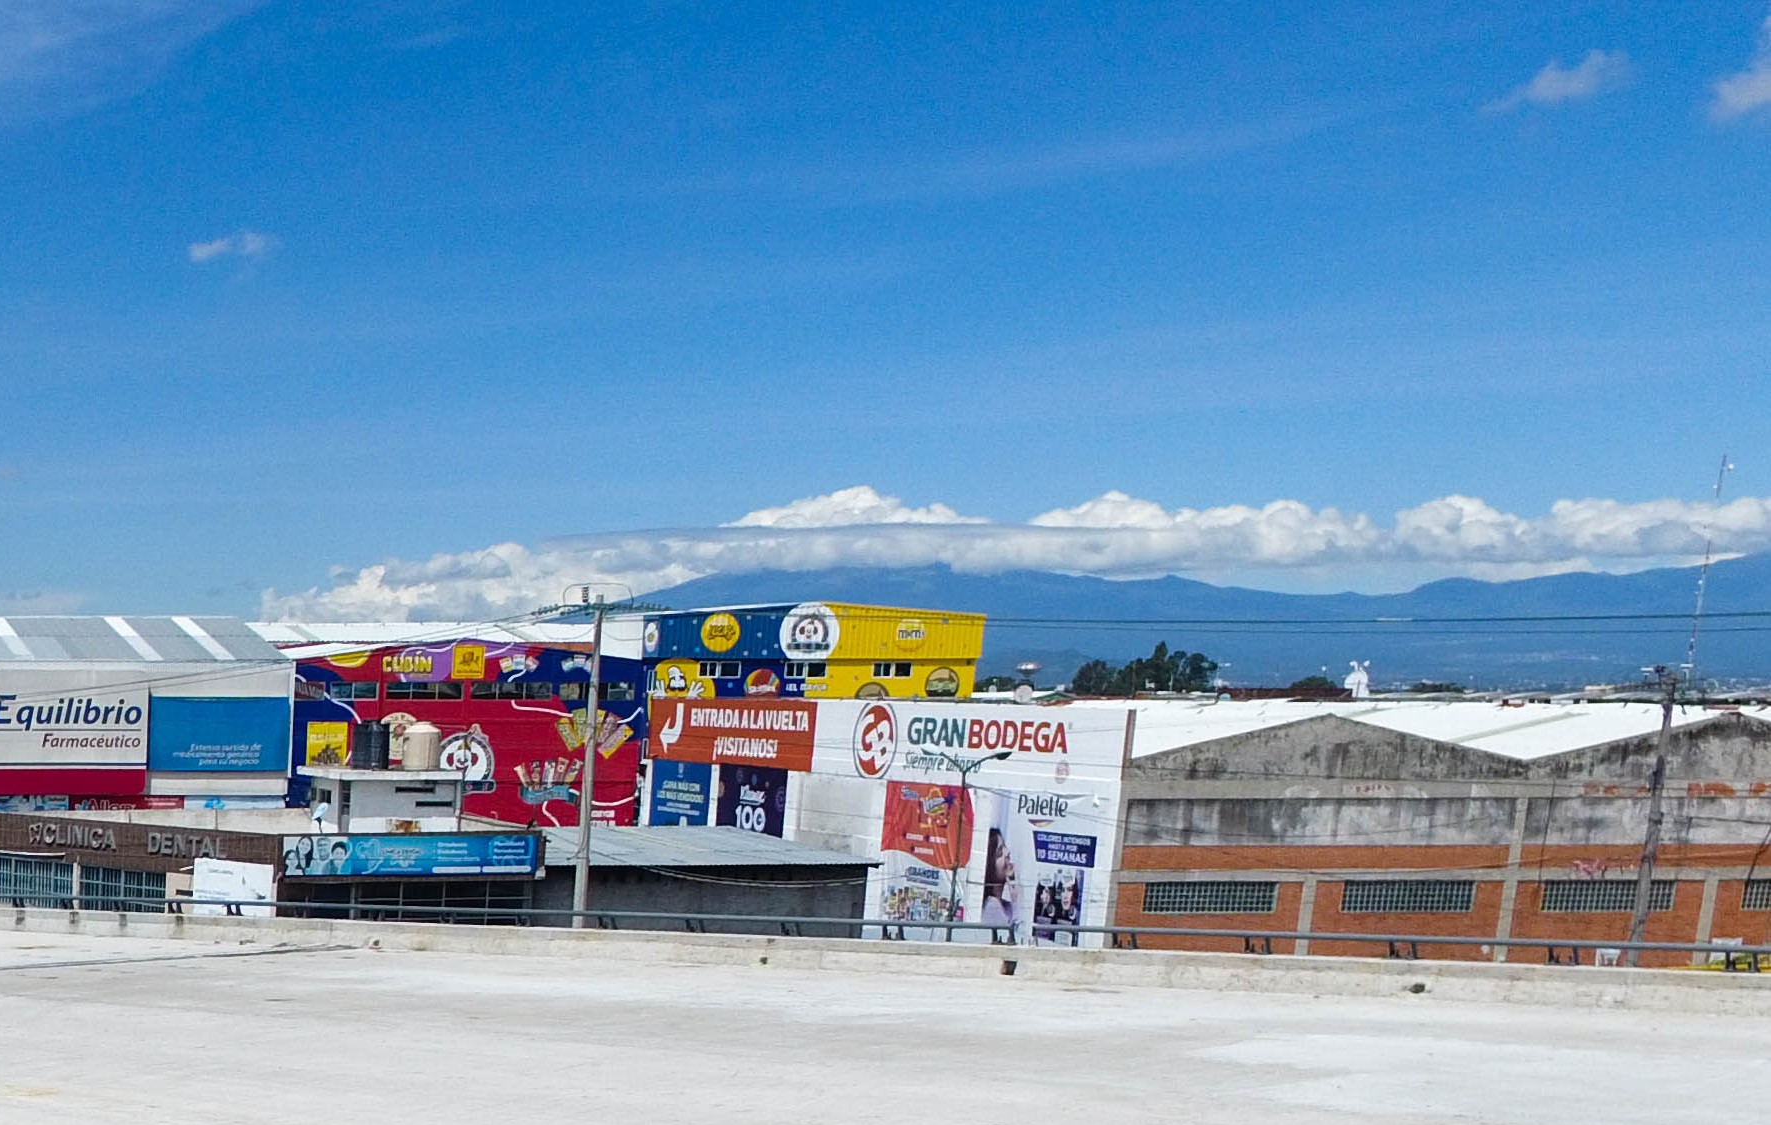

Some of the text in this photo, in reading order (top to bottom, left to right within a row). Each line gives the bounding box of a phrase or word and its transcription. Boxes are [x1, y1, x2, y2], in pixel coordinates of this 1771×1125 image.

[690, 708, 809, 732] ENTRADA A LA VUELTA
[42, 733, 141, 749] Farmacéutico
[1017, 793, 1069, 818] Palette
[43, 823, 228, 858] CLINICA DENTAL
[1047, 850, 1088, 864] SEMANAS
